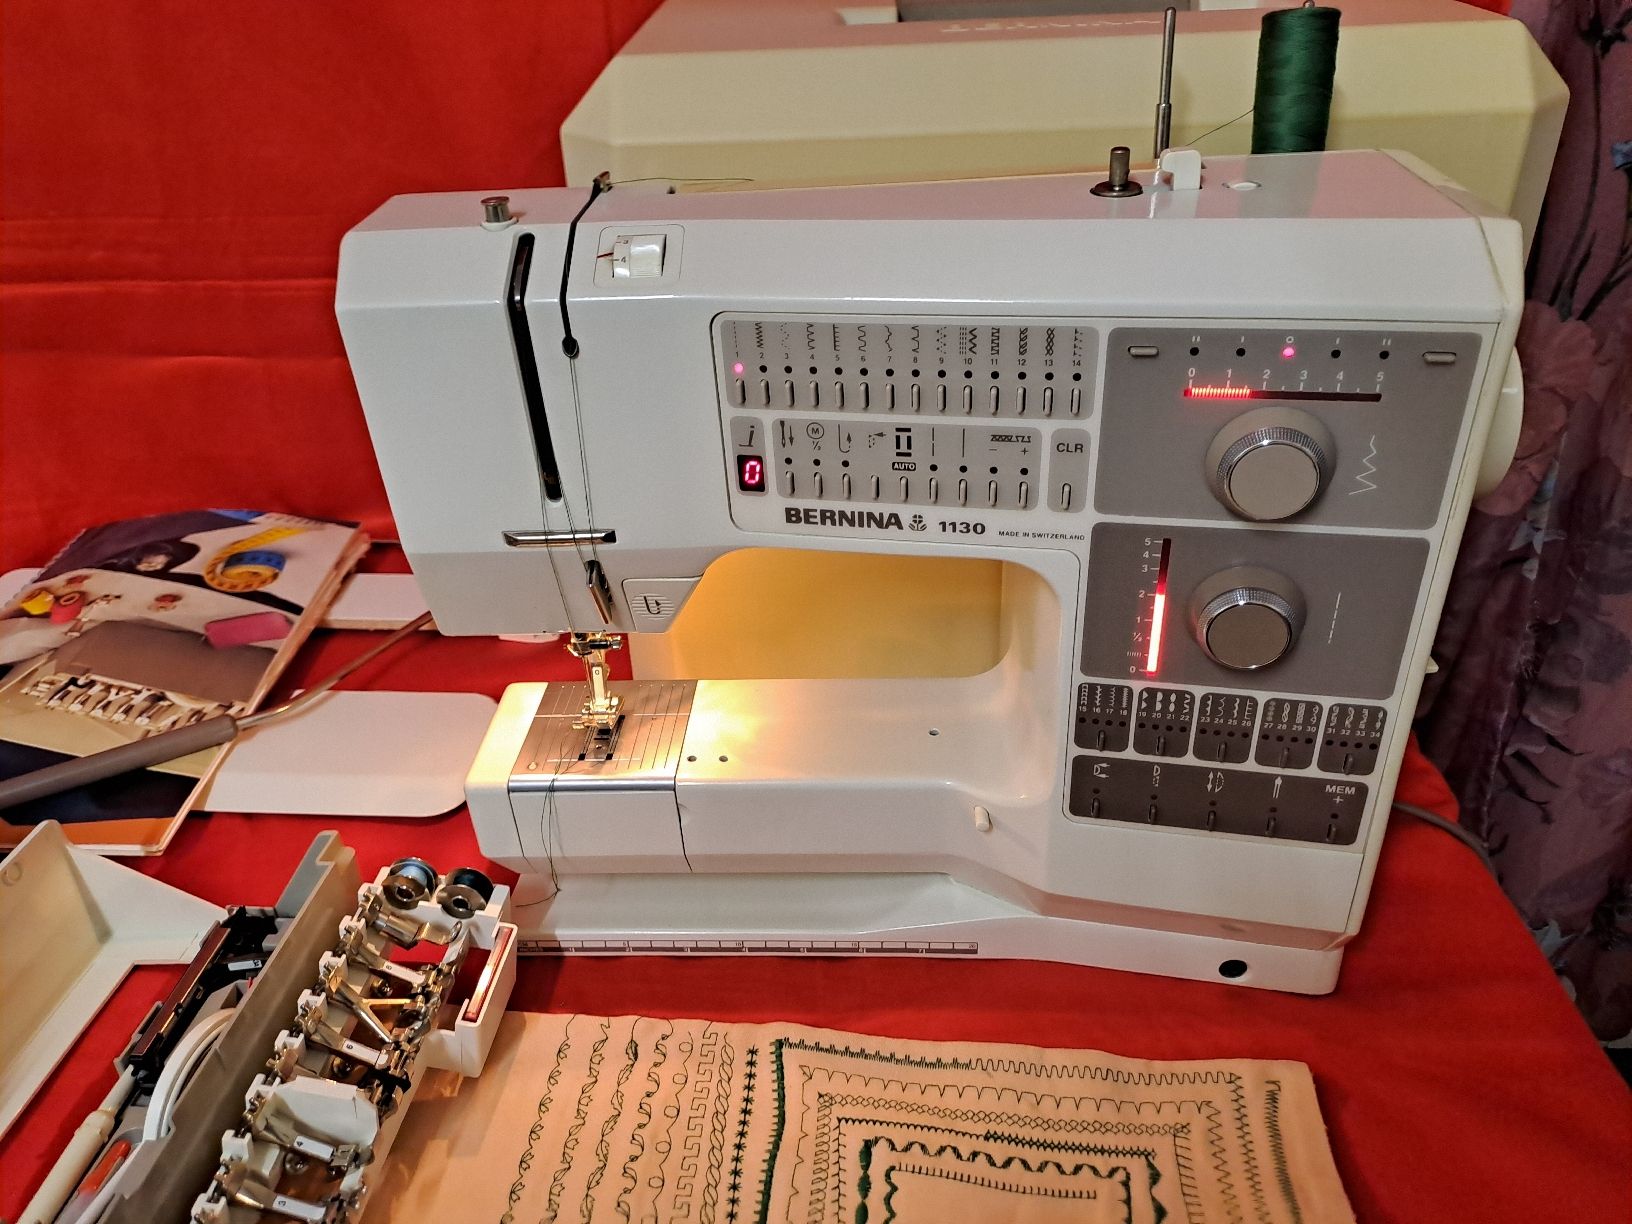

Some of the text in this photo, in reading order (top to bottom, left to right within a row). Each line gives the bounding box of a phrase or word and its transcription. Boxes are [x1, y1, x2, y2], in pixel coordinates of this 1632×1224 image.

[1188, 367, 1384, 382] 0 1 2 3 4 5
[1056, 442, 1084, 453] CLR
[744, 460, 760, 484] 0
[785, 507, 904, 530] BERNINA
[939, 521, 986, 534] 1130
[1032, 532, 1085, 540] SWITZERLAND
[1144, 538, 1151, 546] 5
[1142, 564, 1148, 572] 3
[1138, 590, 1145, 598] 2
[1325, 784, 1356, 795] MEM
